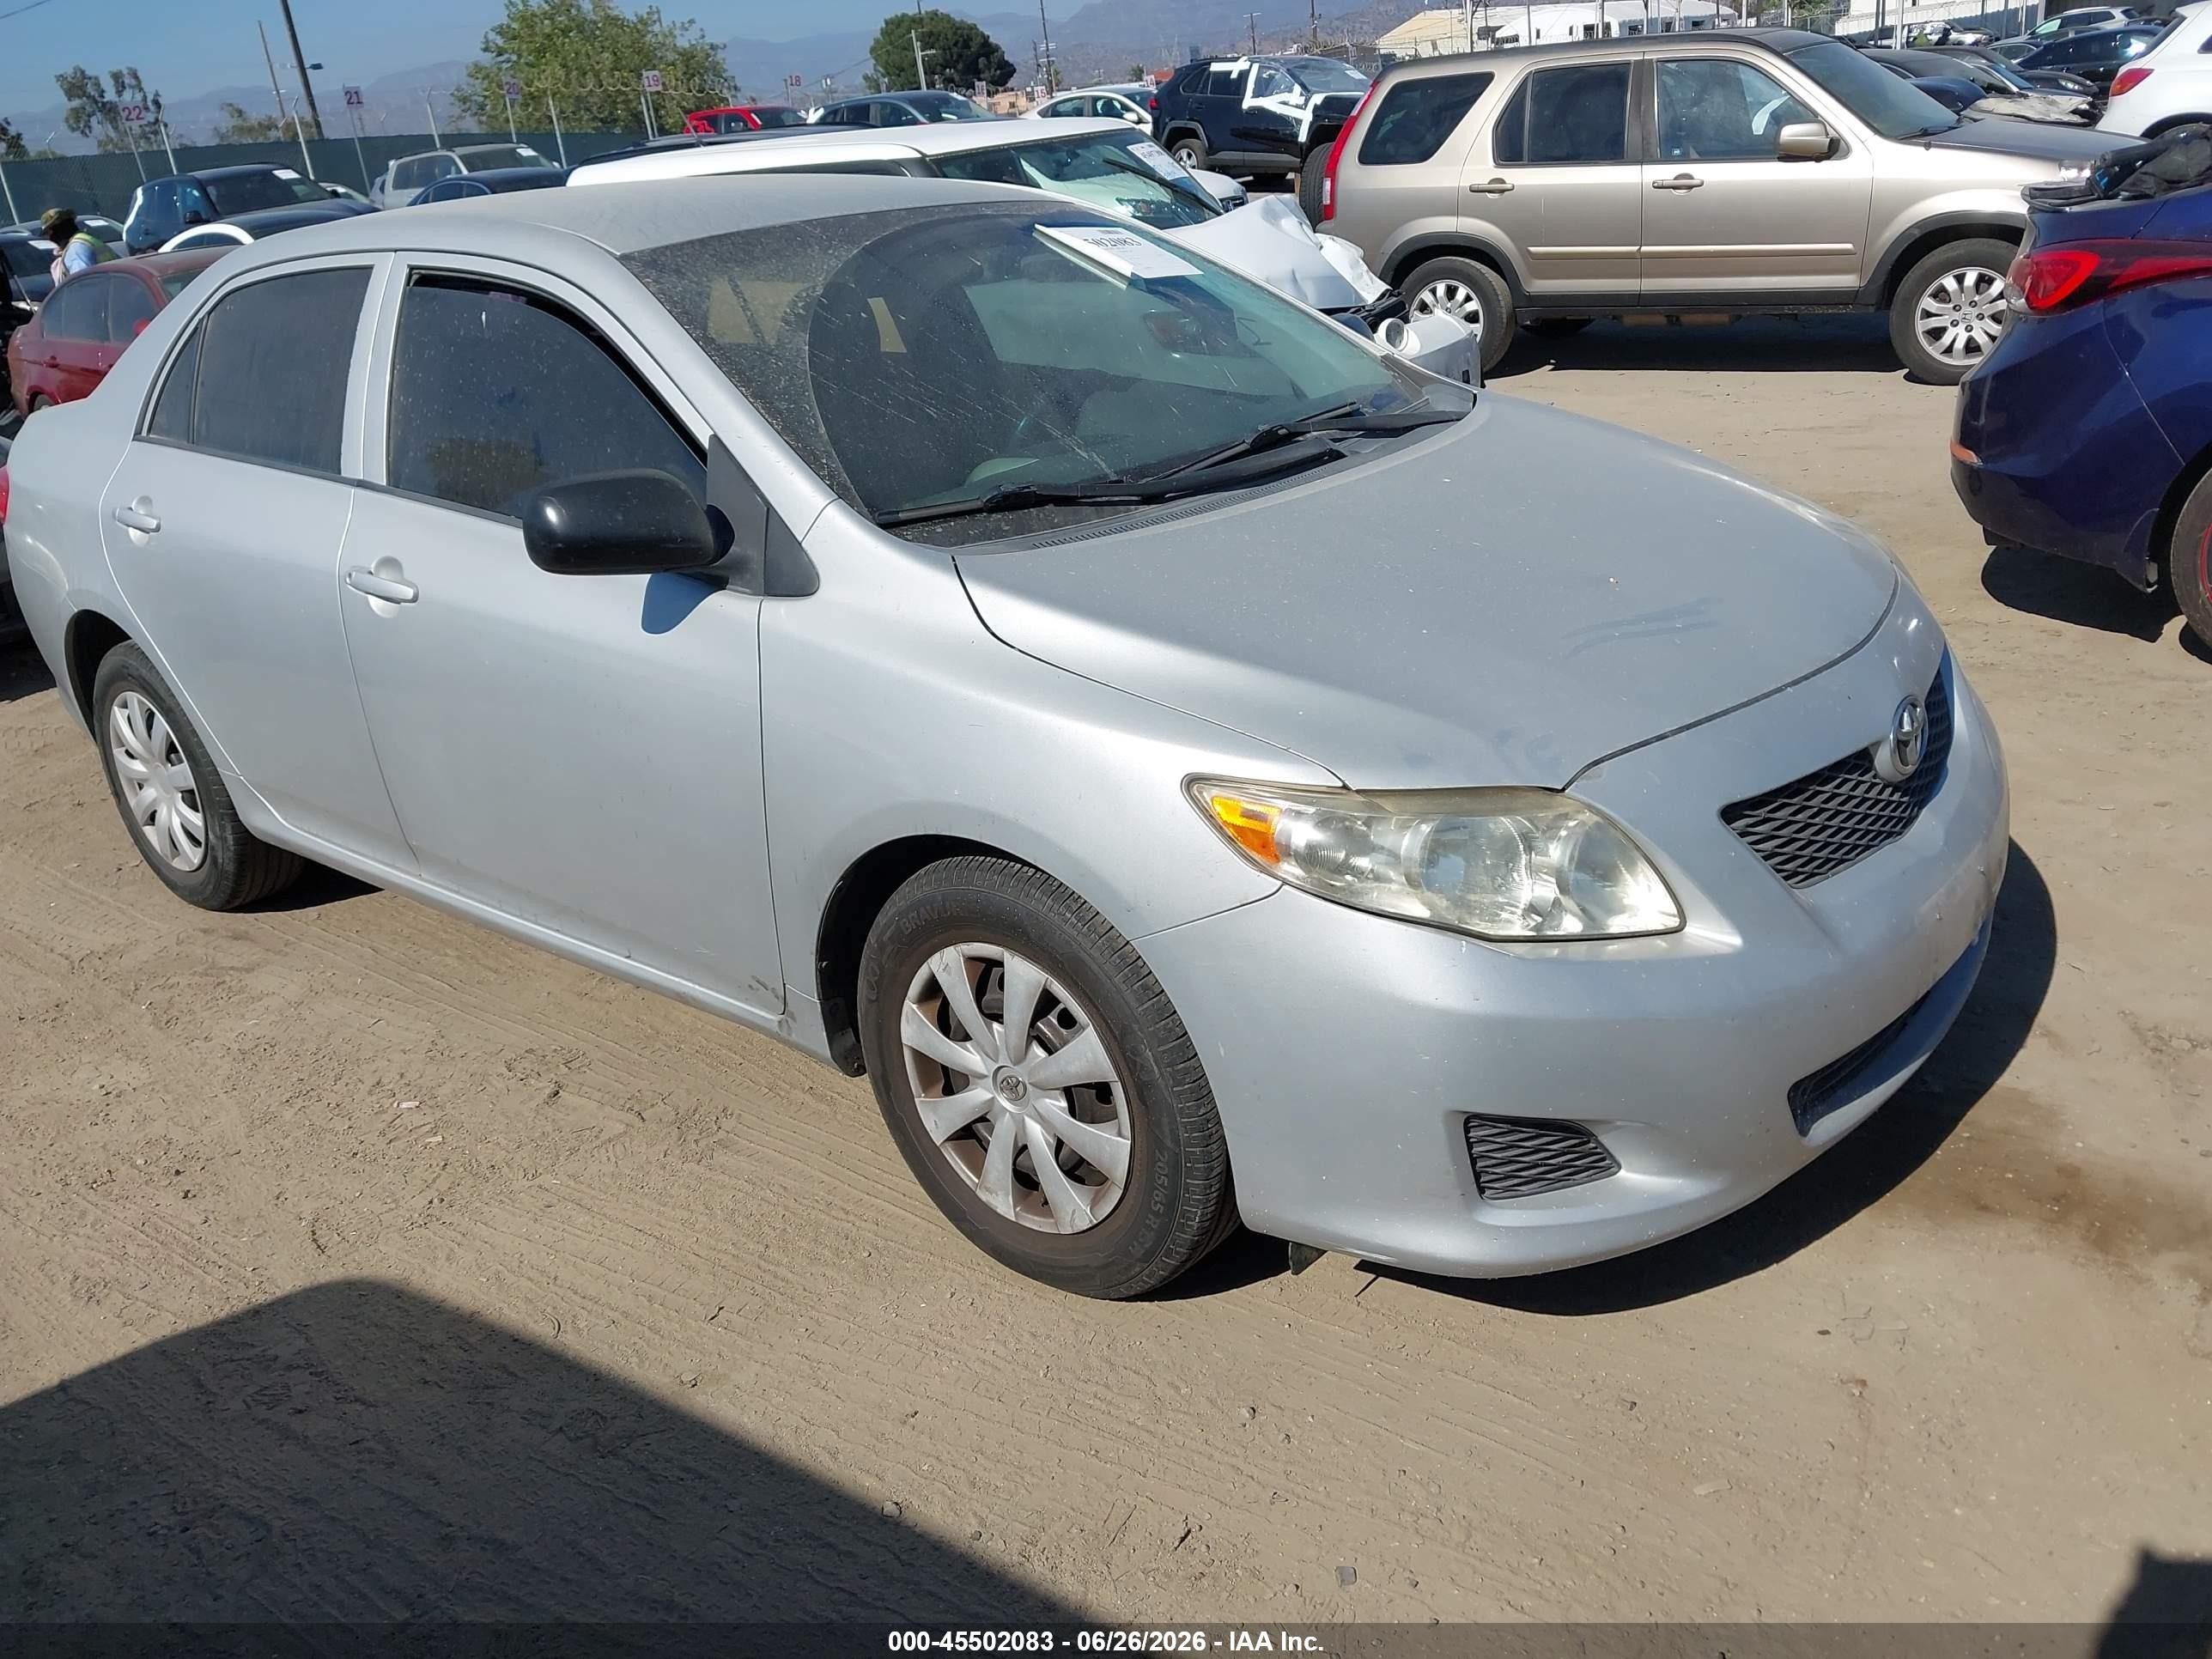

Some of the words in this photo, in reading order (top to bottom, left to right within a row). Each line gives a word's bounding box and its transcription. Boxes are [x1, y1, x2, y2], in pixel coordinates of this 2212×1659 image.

[645, 74, 660, 88] 19
[789, 75, 802, 87] 18
[344, 90, 363, 105] 21
[122, 105, 145, 122] 22
